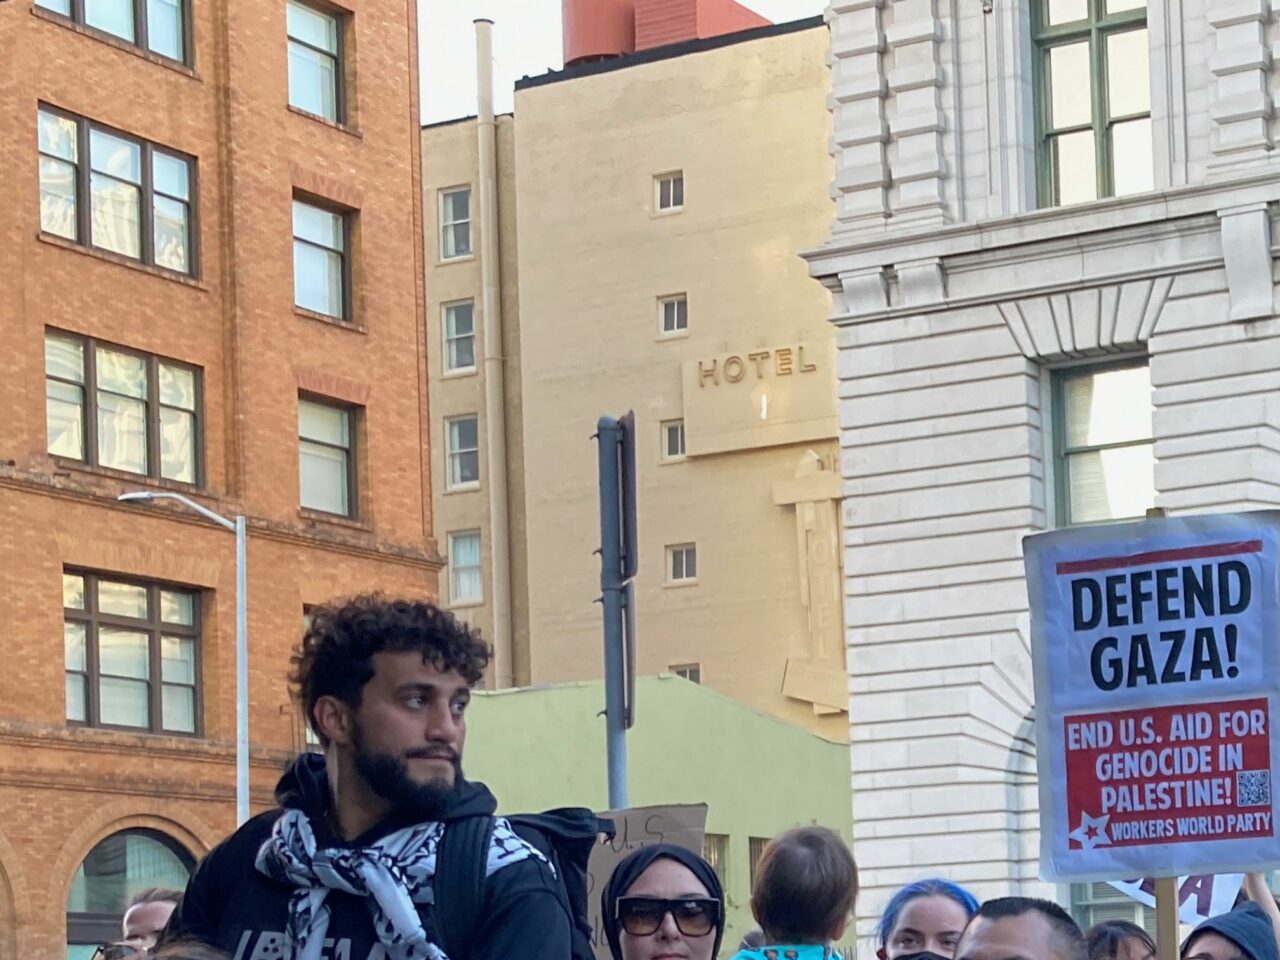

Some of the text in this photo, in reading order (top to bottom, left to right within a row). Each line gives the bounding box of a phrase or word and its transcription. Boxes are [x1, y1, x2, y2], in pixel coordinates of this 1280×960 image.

[697, 345, 817, 388] HOTEL
[1071, 560, 1251, 632] DEFEND
[1090, 623, 1239, 691] GAZA!
[1068, 709, 1266, 750] END U.S. AID FOR
[1095, 743, 1244, 781] GENOCIDE IN
[1101, 777, 1232, 814] PALESTINE!
[1111, 812, 1272, 841] WORKERS WORLD PARTY
